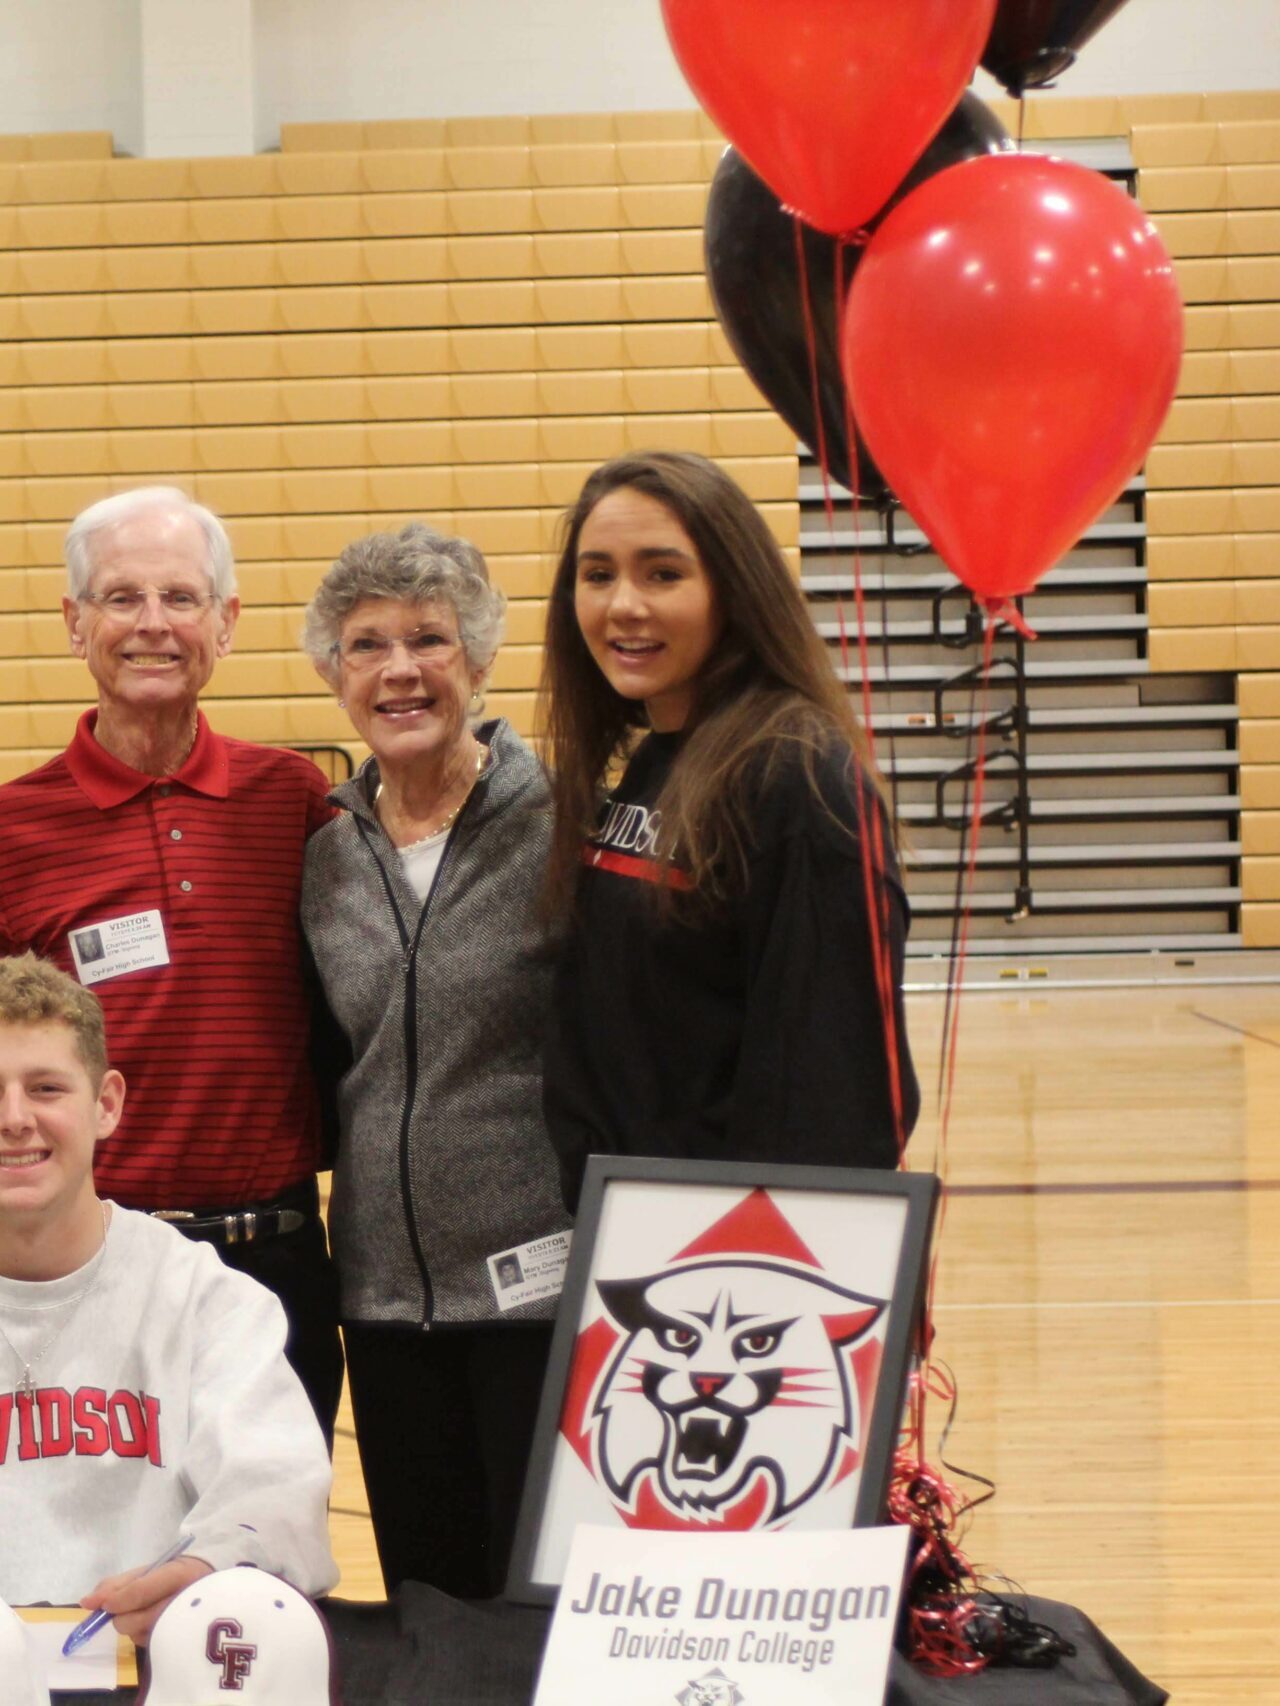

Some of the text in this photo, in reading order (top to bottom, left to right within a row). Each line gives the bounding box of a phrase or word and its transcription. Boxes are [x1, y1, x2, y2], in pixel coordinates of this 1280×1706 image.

[109, 916, 148, 931] VISITOR
[106, 939, 130, 950] Charles
[131, 933, 160, 943] Dunagan
[92, 955, 155, 977] Cy-Fair High School
[526, 1236, 566, 1254] VISITOR
[524, 1264, 540, 1275] Mary
[511, 1290, 533, 1302] Cy-Fair
[534, 1284, 551, 1294] High
[571, 1573, 891, 1632] Jake Dunagan
[609, 1626, 835, 1673] Davidson College
